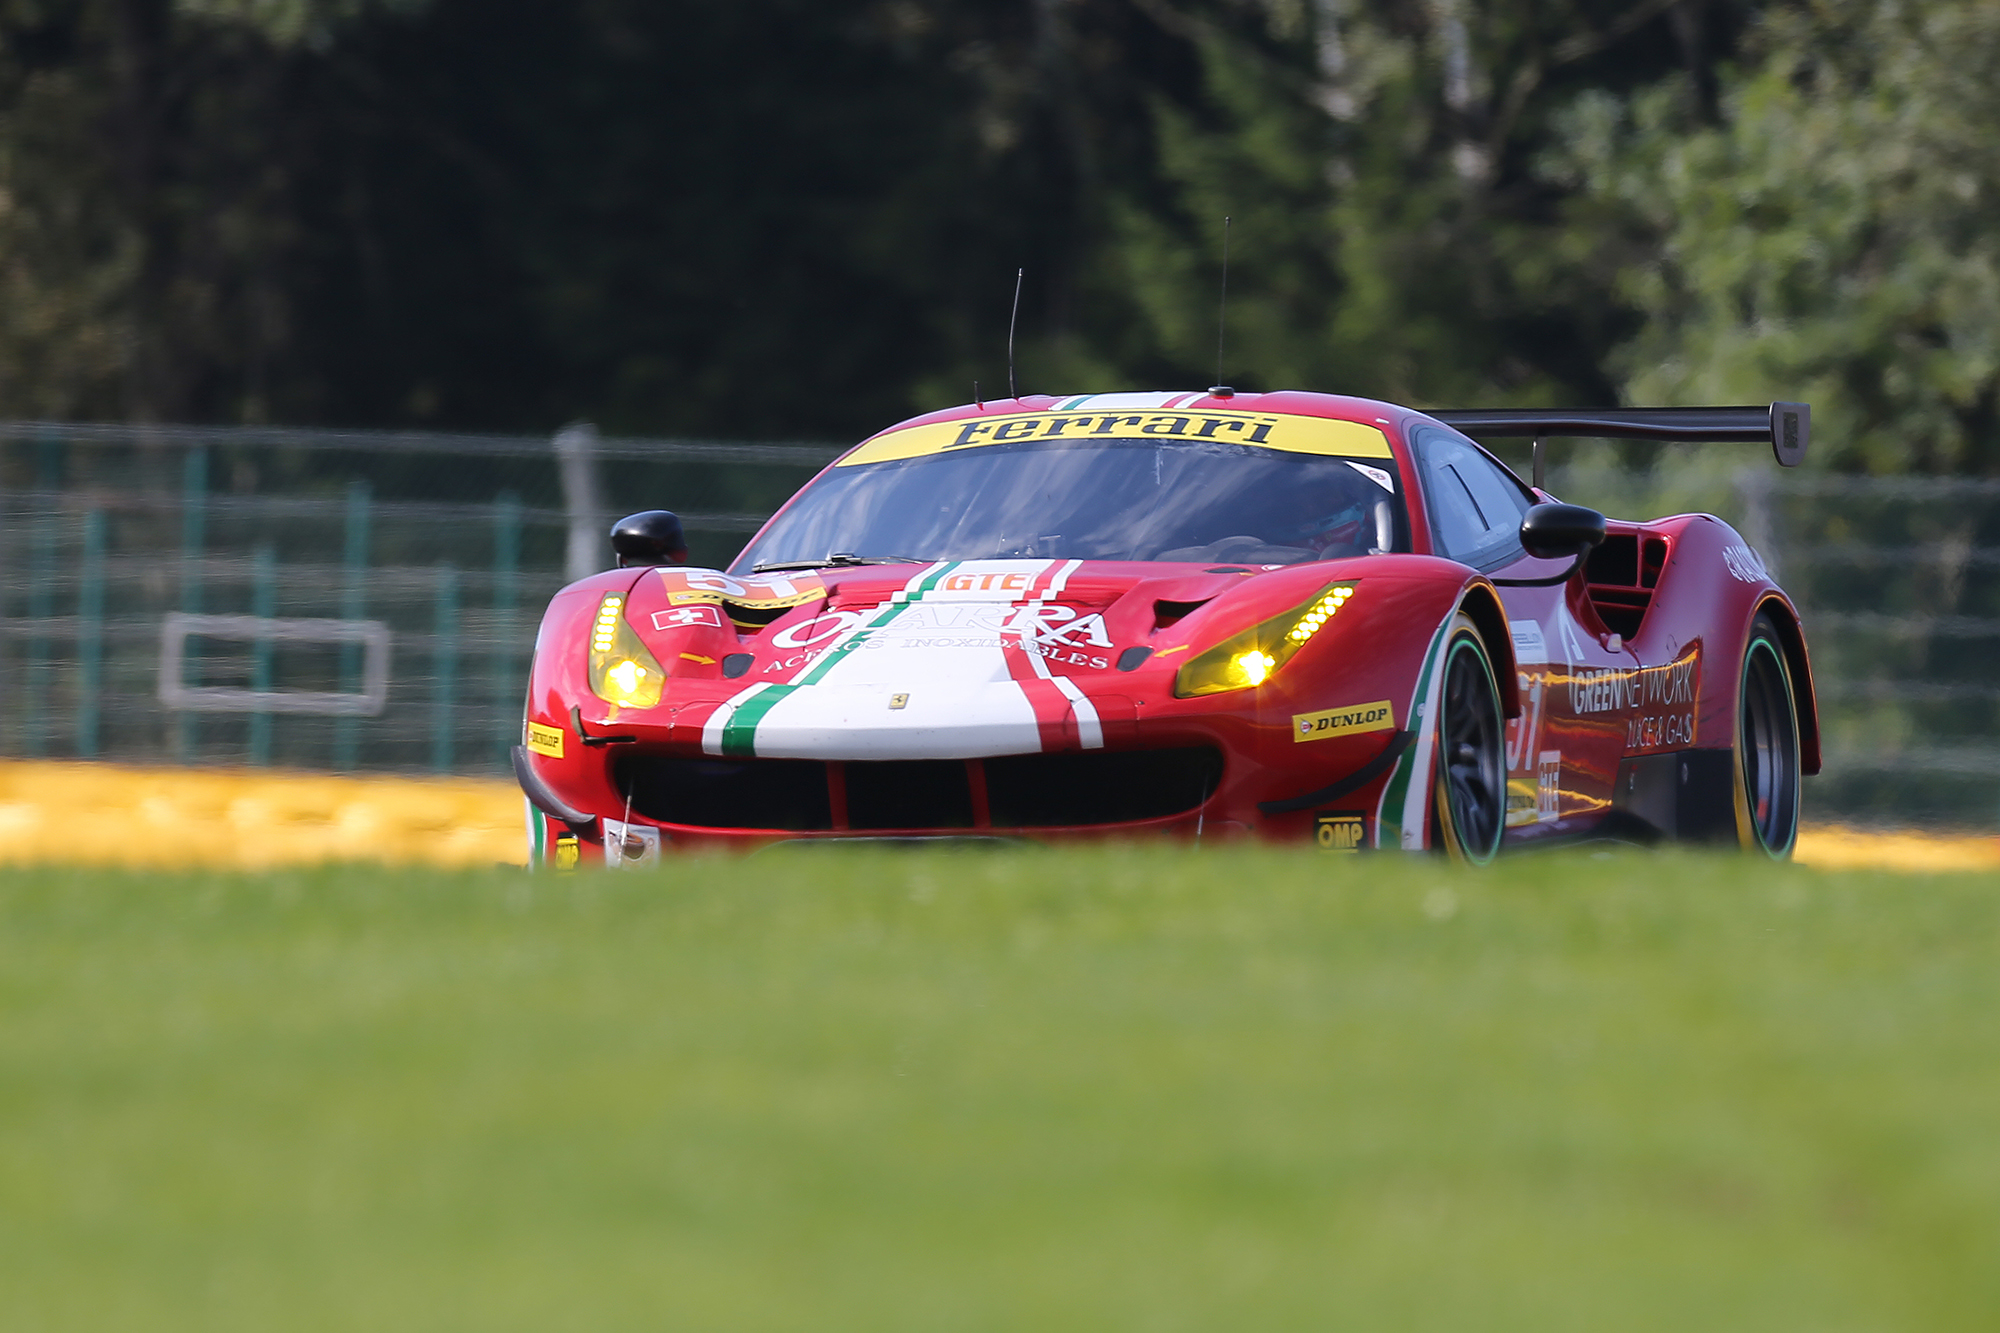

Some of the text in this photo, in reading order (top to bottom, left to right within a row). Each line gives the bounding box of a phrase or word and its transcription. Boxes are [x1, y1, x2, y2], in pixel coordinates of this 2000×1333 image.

[940, 416, 1278, 449] Ferrari
[686, 572, 798, 598] 51
[945, 573, 1028, 590] GTE
[772, 605, 1114, 648] OLARRA
[899, 637, 1110, 670] INOXIDABLES
[1316, 708, 1387, 731] DUNLOP
[1655, 716, 1663, 746] &
[1665, 713, 1693, 744] GAS
[1318, 823, 1363, 848] OMP
